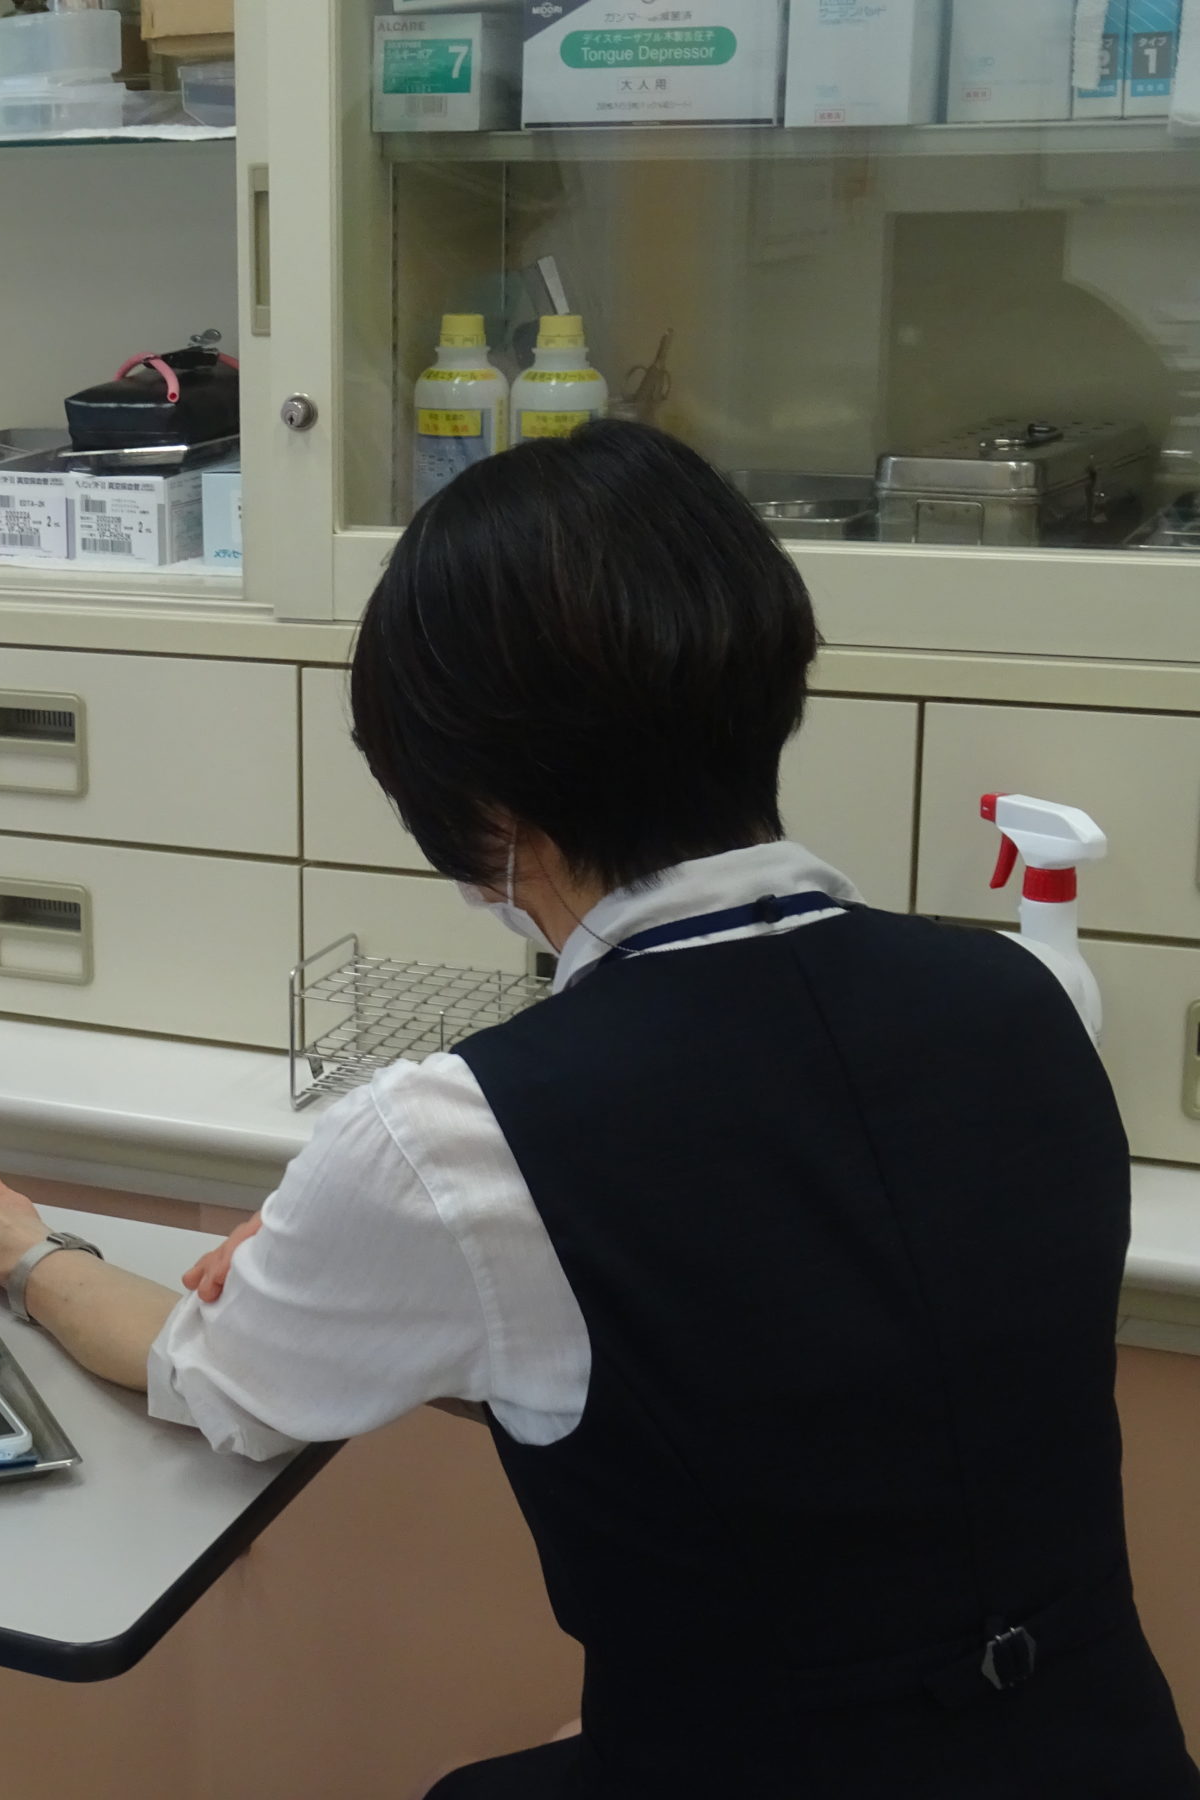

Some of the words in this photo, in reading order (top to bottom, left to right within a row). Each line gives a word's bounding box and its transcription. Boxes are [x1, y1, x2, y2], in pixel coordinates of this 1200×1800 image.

[377, 21, 427, 32] ALCARE
[448, 45, 469, 79] 7
[581, 47, 634, 64] Tongue
[638, 45, 716, 63] Depressor
[1143, 48, 1158, 74] 1
[46, 515, 52, 528] 2
[138, 521, 144, 533] 2
